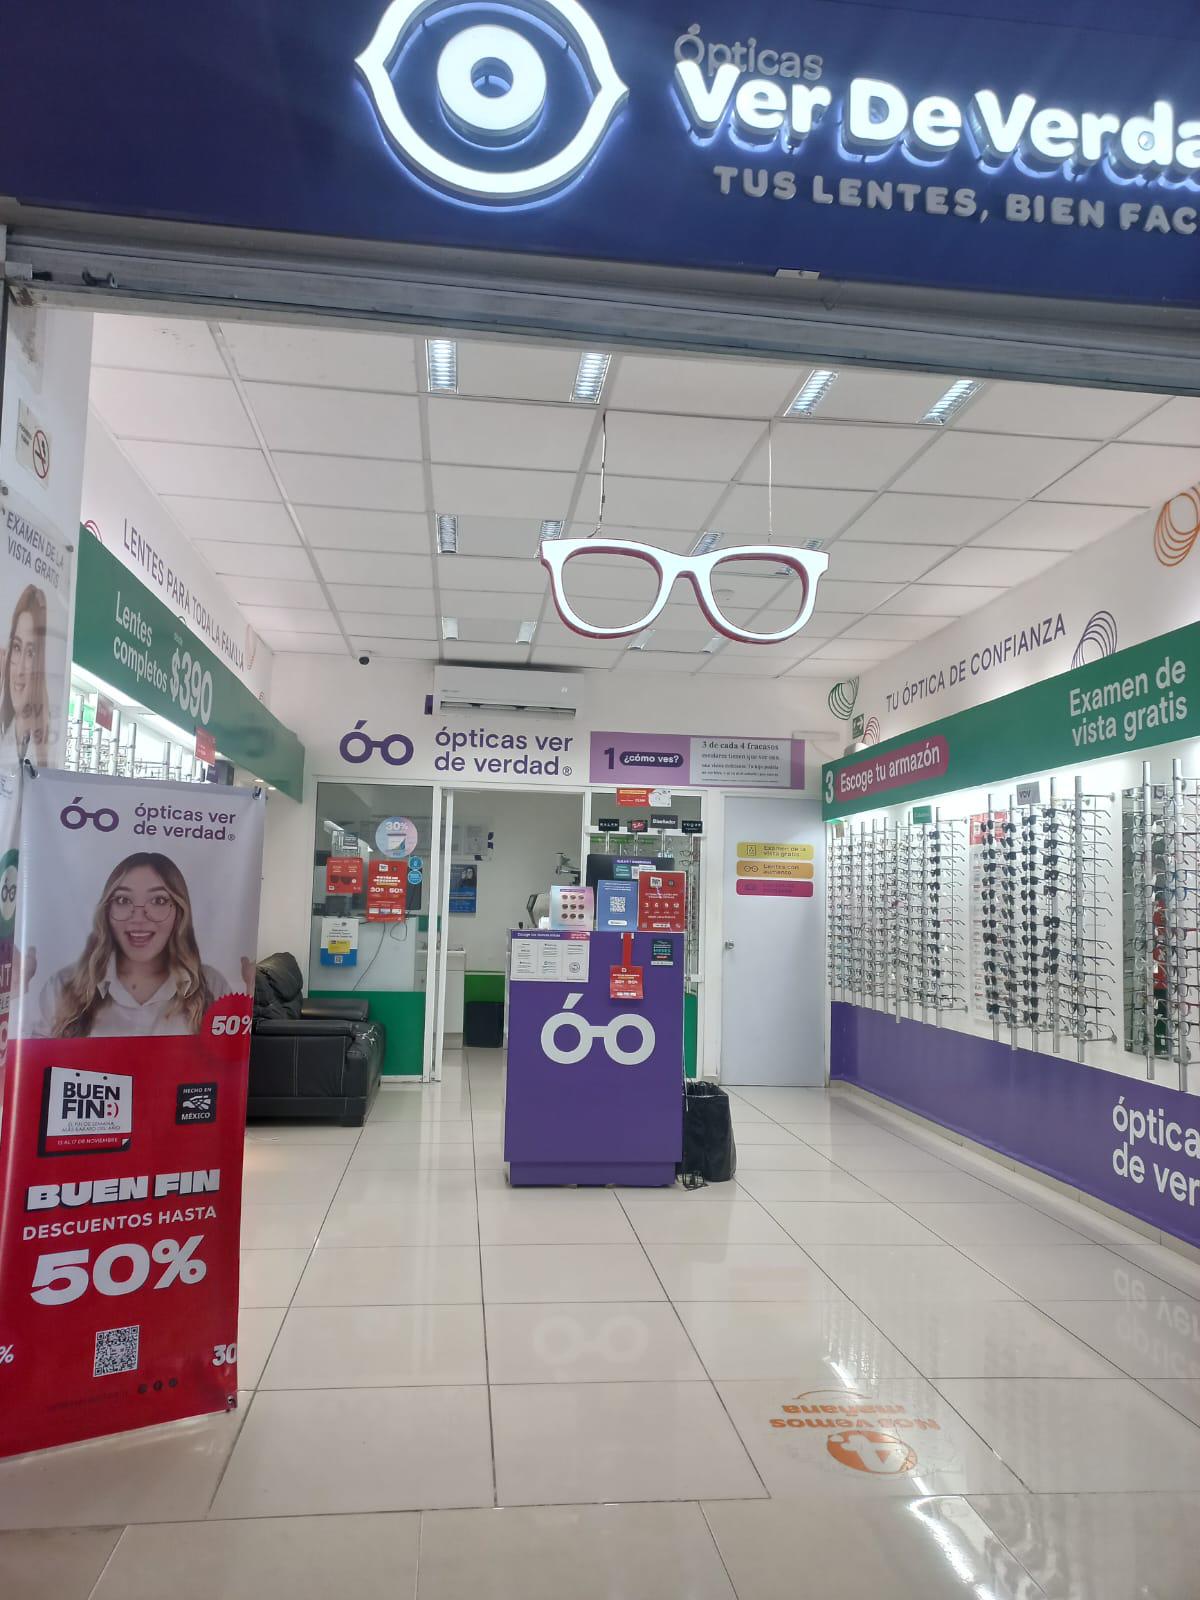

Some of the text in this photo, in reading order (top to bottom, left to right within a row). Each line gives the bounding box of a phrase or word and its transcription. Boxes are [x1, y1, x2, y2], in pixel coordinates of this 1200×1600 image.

[673, 24, 823, 81] Ópticas
[672, 59, 833, 146] Ver
[843, 77, 963, 156] De
[712, 165, 797, 200] TUS
[811, 175, 990, 223] LENTES,
[1005, 193, 1105, 228] BIEN
[6, 511, 45, 553] EXAMEN
[8, 535, 60, 589] VISTA GRATIS
[123, 517, 164, 587] LENTES
[165, 570, 191, 617] PARA
[192, 603, 211, 634] TODA
[209, 624, 221, 647] LA
[221, 631, 244, 673] FAMILIA
[114, 590, 153, 647] Lentes
[113, 635, 213, 726] completos $390
[886, 612, 1067, 714] TU ÓPTICA DE CONFIANZA
[1069, 656, 1187, 718] Examen de
[435, 727, 574, 752] ópticas ver
[1071, 693, 1188, 748] vista gratis
[434, 751, 466, 772] de
[604, 747, 680, 770] 1 ¿cómo ves?
[709, 741, 719, 749] de
[747, 743, 779, 751] fracasos
[824, 743, 940, 805] 3 Escoge tu armazón
[133, 820, 158, 836] de
[134, 802, 237, 825] ópticas ver
[63, 1081, 121, 1101] BUEN
[183, 1087, 203, 1095] HECHO
[181, 1111, 211, 1121] MÉXICO
[1112, 1142, 1146, 1184] de
[26, 1168, 221, 1211] BUEN FIN
[22, 1205, 217, 1241] DESCUENTOS HASTA
[30, 1234, 207, 1306] 50%
[769, 1418, 874, 1429] vemos
